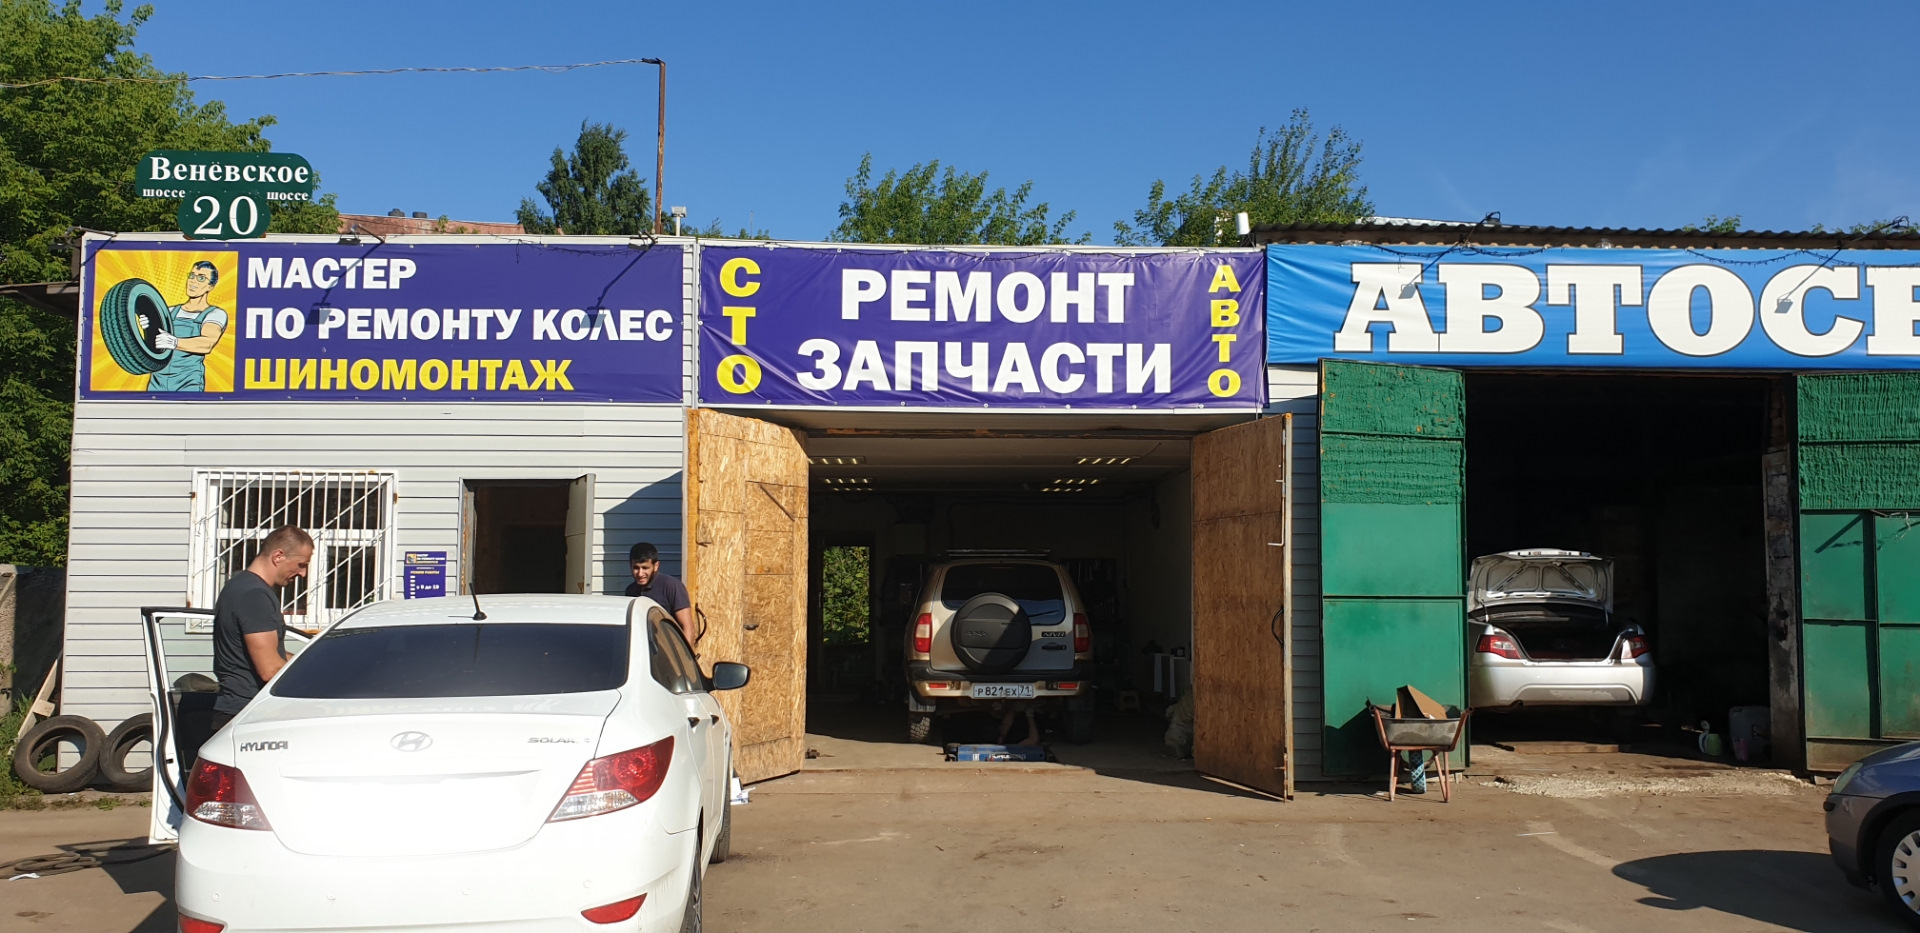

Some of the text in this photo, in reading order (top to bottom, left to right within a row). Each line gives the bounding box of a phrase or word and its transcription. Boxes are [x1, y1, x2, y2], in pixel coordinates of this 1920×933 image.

[149, 156, 309, 183] Венёвское
[142, 188, 186, 198] шоссе
[266, 191, 309, 201] шоссе
[193, 195, 258, 235] 20
[246, 257, 417, 289] МАСТЕР
[840, 269, 1135, 324] РЕМОНТ
[245, 307, 674, 341] ПО РЕМОНТУ КОЛЕС
[716, 257, 762, 394] СТО
[1207, 264, 1241, 398] АВТО
[244, 358, 575, 391] ШИНОМОНТАЖ
[796, 338, 1171, 393] ЗАПЧАСТИ
[240, 741, 288, 752] HYUNDAI
